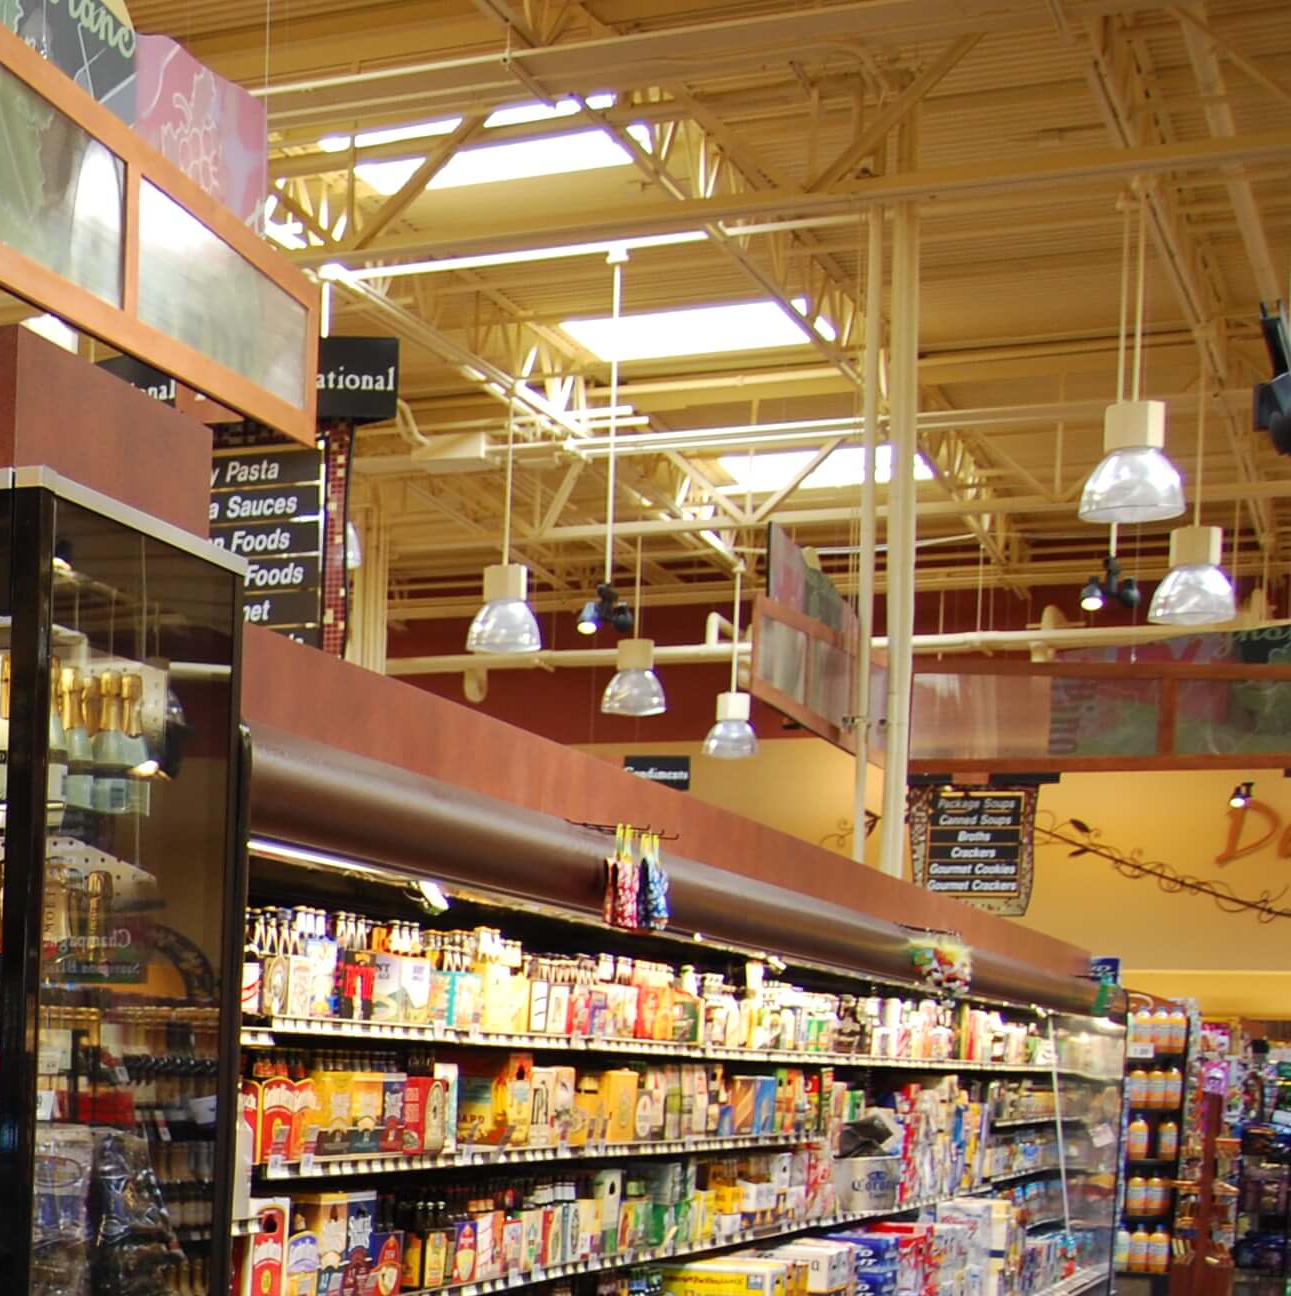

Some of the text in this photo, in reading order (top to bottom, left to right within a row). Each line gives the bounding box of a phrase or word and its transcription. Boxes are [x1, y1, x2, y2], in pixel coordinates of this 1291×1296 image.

[315, 367, 395, 392] ational
[225, 460, 279, 483] Pasta
[226, 495, 297, 519] Sauces
[231, 529, 290, 553] Foods
[244, 563, 304, 587] Foods
[938, 798, 1016, 811] Package Soups
[939, 814, 1012, 826] Canned Soups
[958, 830, 991, 842] Broths
[951, 847, 996, 858] Crackers
[930, 863, 1017, 875] Gourmet Cookies
[971, 879, 1017, 891] Crackers
